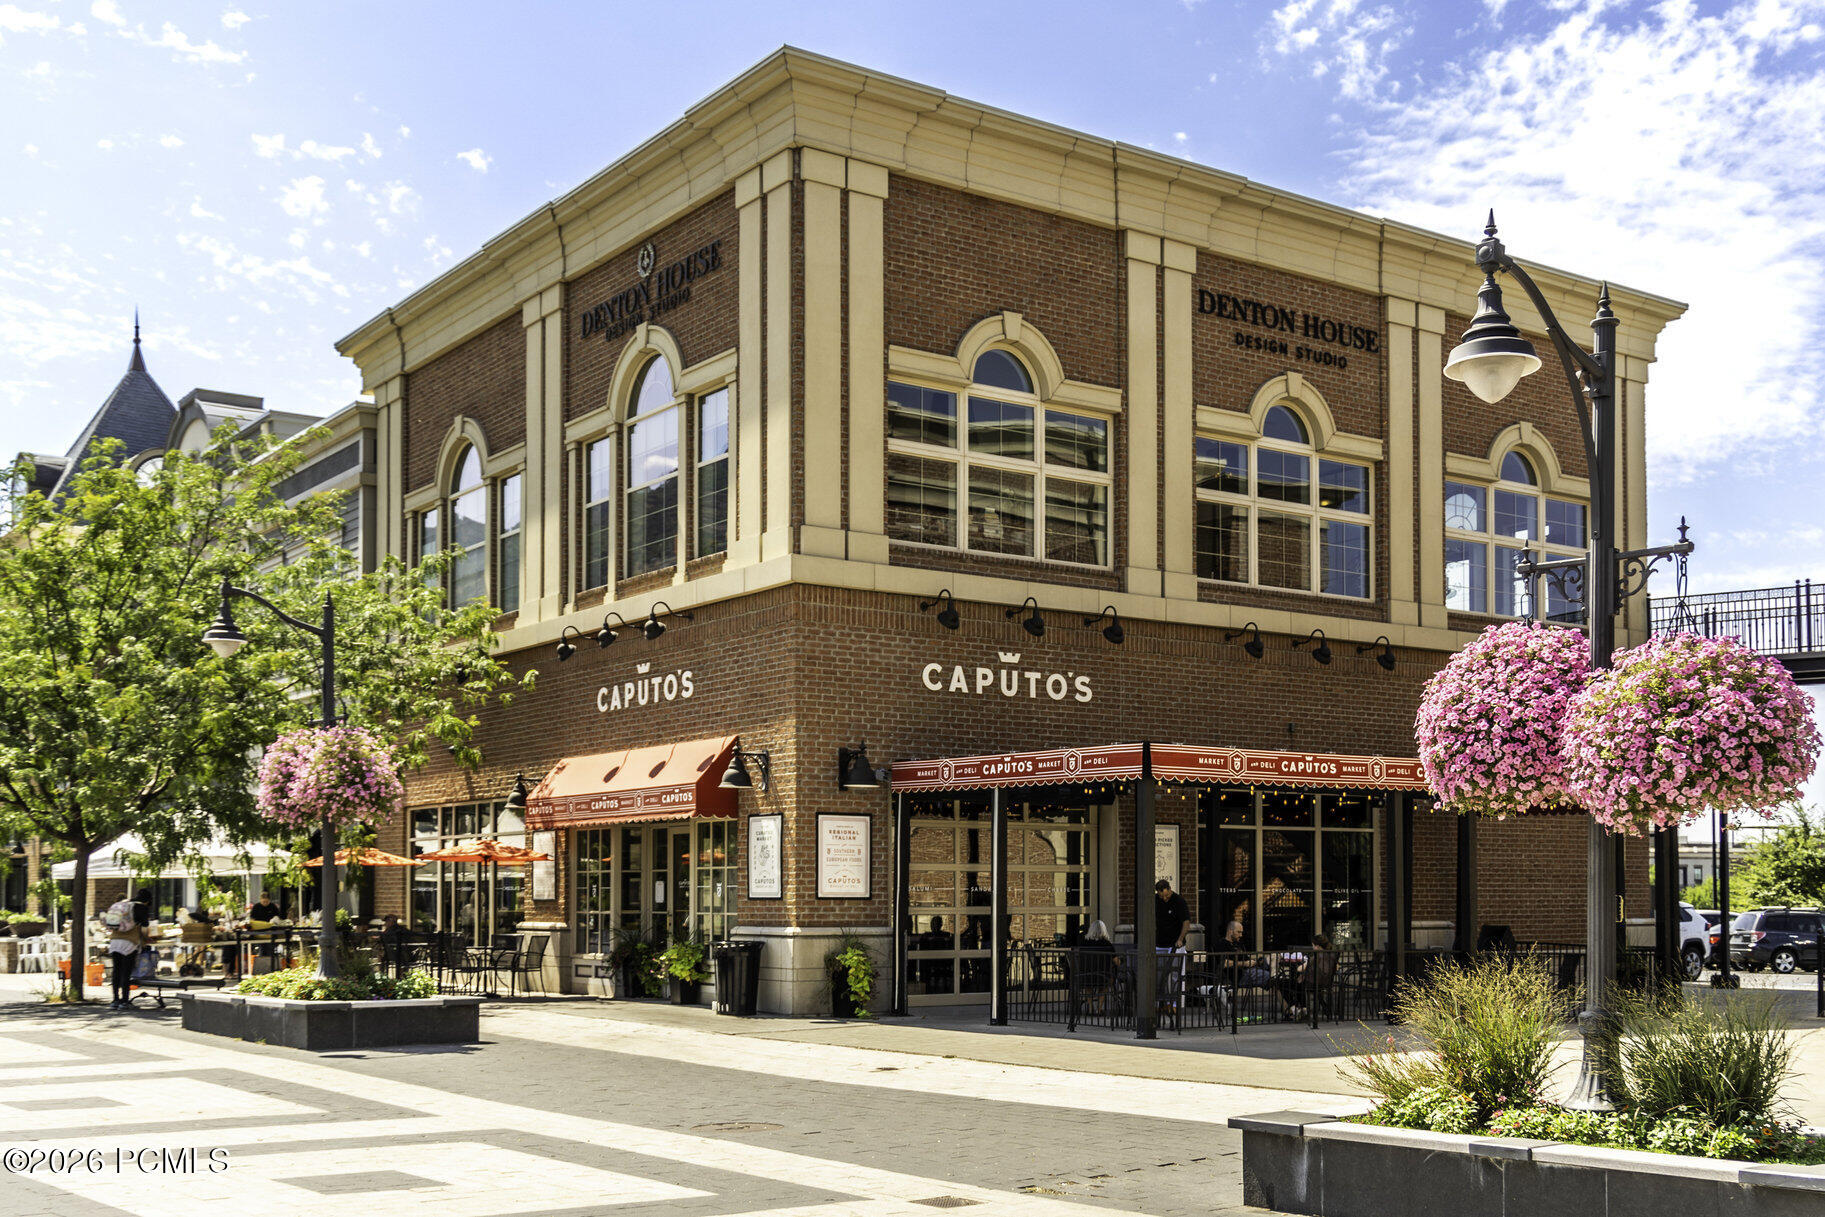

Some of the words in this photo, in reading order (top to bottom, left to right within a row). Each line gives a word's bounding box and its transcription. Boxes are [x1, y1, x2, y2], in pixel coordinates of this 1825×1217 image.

[581, 278, 651, 339] DENTON
[655, 239, 722, 298] HOUSE
[1198, 289, 1296, 333] DENTON
[1302, 314, 1379, 353] HOUSE
[1234, 332, 1288, 354] DESIGN
[1296, 346, 1347, 369] STUDIO
[597, 669, 694, 712] CAPUTO'S
[922, 663, 1093, 703] CAPUTO'S
[917, 769, 937, 777] MARKET
[982, 760, 1033, 775] CAPUTO'S
[1038, 760, 1061, 768] MARKET
[1093, 757, 1108, 765] DELI
[1281, 761, 1337, 774] CAPUTO'S
[662, 792, 693, 803] CAPUTO'S
